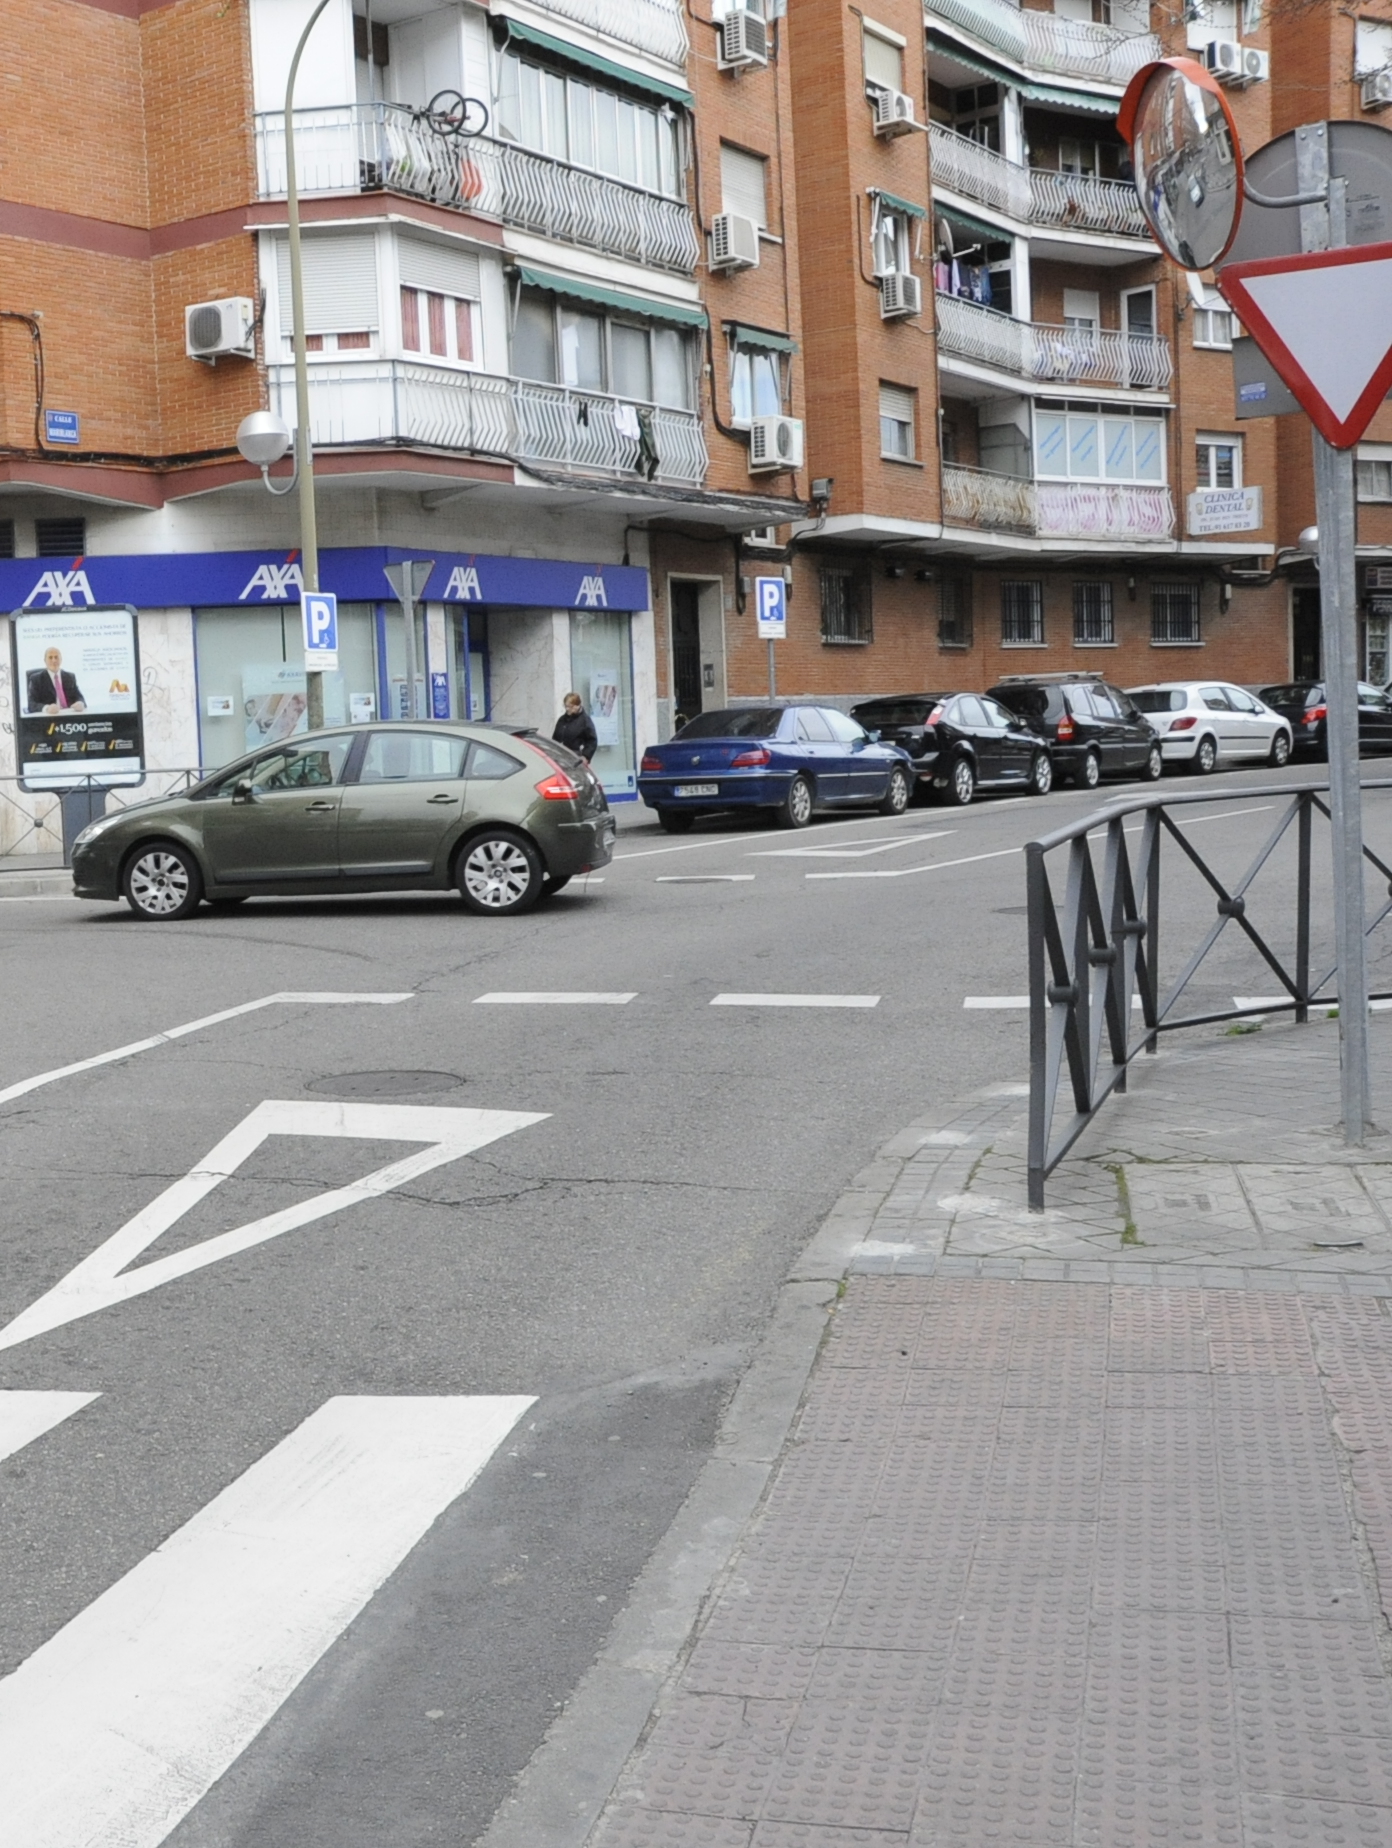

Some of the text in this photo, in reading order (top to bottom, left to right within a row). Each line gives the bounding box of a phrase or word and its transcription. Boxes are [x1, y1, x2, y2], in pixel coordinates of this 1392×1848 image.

[1204, 502, 1245, 515] DENTAL
[22, 570, 96, 607] AXA
[238, 563, 304, 600] AXA
[443, 566, 482, 600] AXA
[574, 575, 607, 607] AXA
[763, 583, 780, 617] P
[310, 600, 331, 644] P
